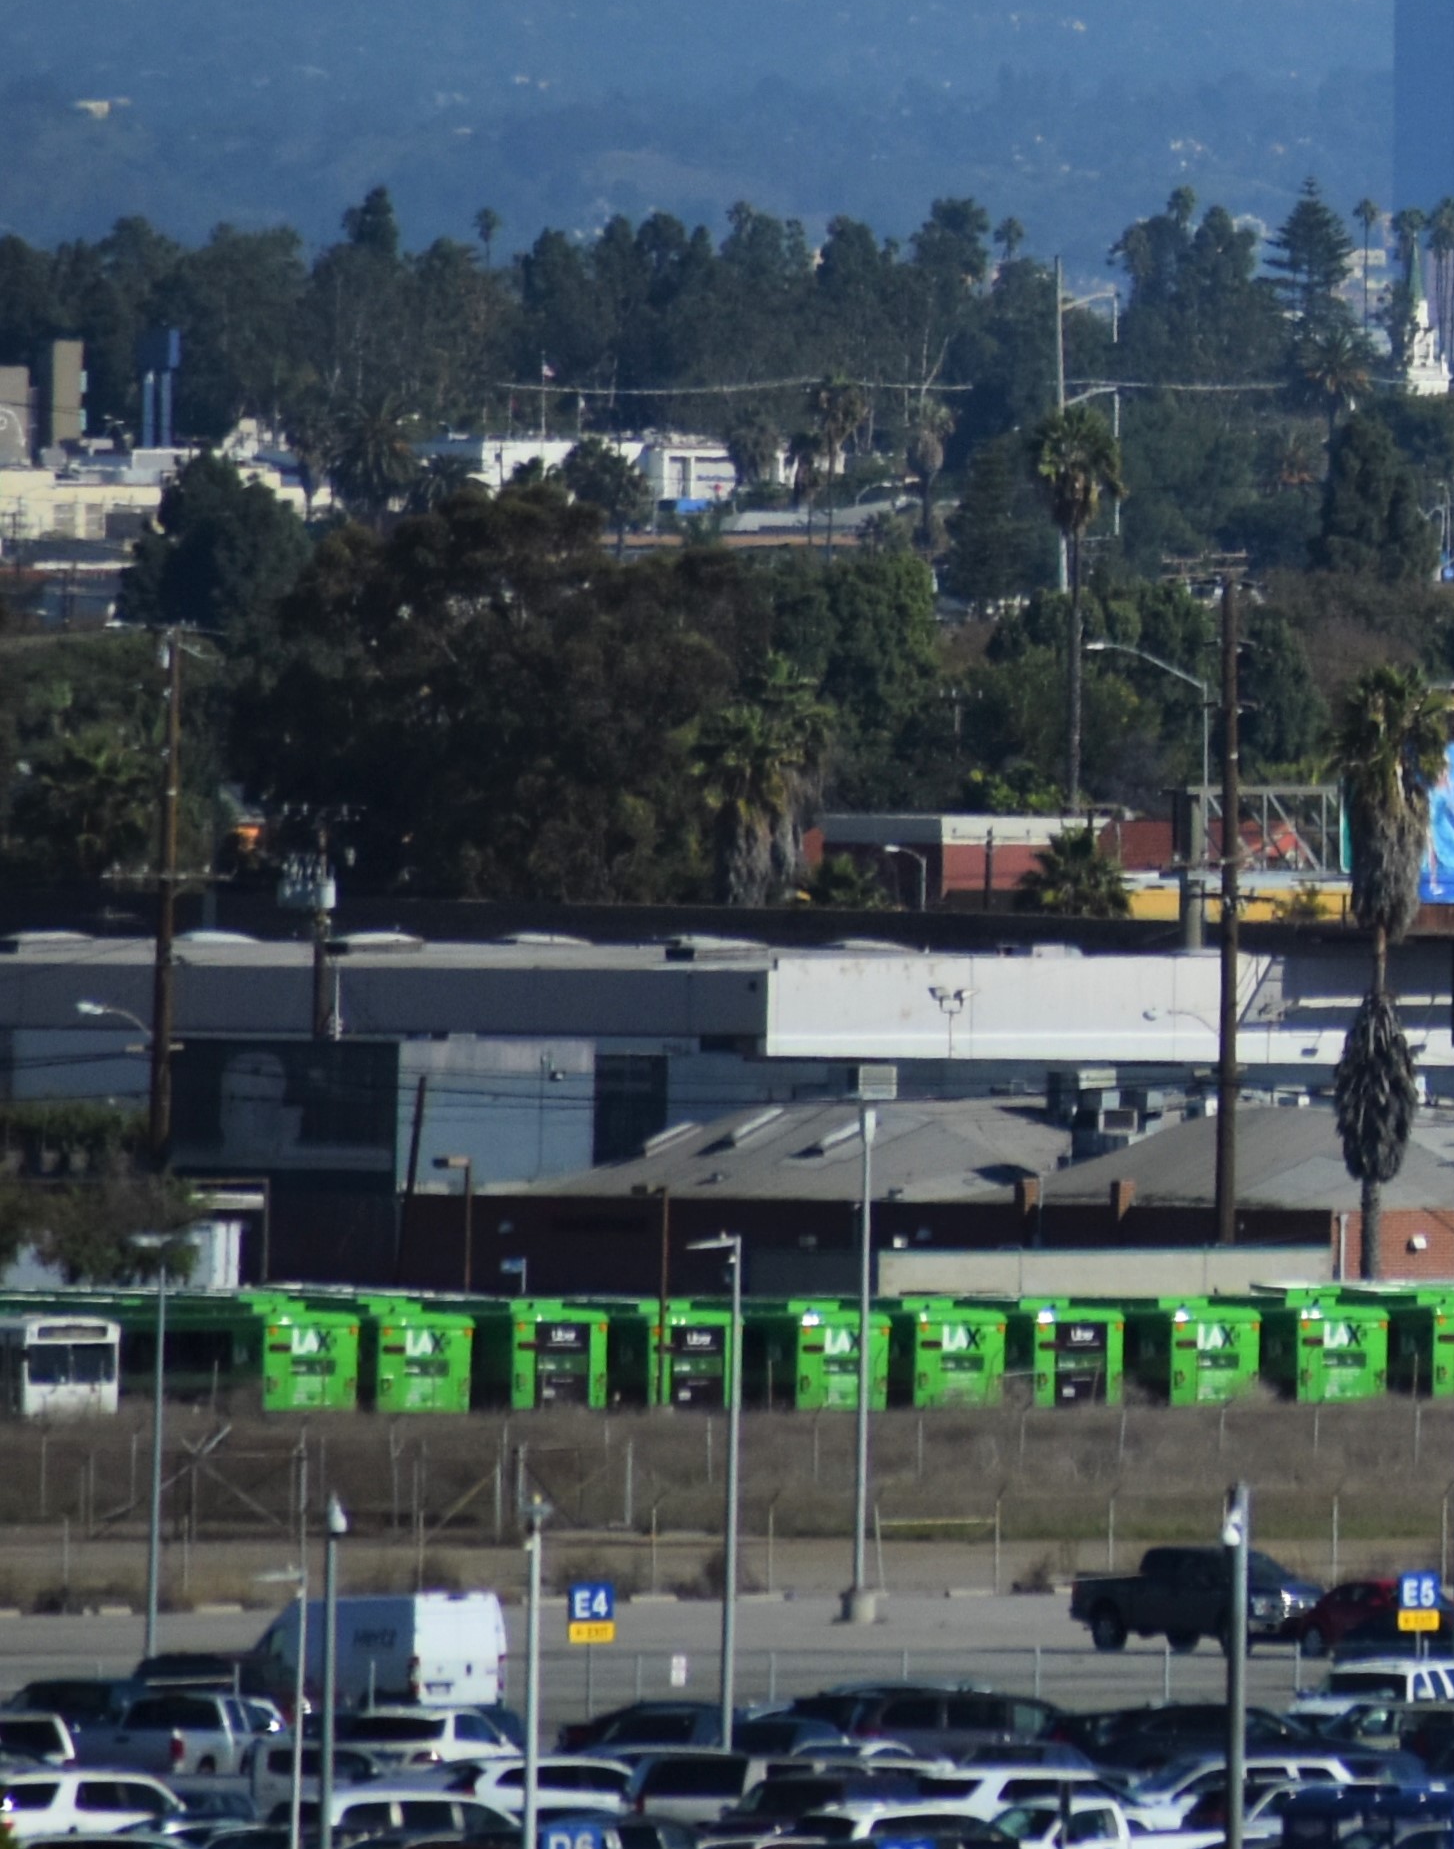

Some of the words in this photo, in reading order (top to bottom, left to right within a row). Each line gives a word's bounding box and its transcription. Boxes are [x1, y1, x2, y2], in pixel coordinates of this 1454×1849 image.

[291, 1327, 331, 1355] LAX
[405, 1328, 445, 1356] LAX
[941, 1324, 981, 1352] LAX
[1196, 1322, 1234, 1350] LAX
[1323, 1320, 1361, 1349] LAX
[574, 1588, 609, 1619] E4
[1402, 1577, 1436, 1607] E5
